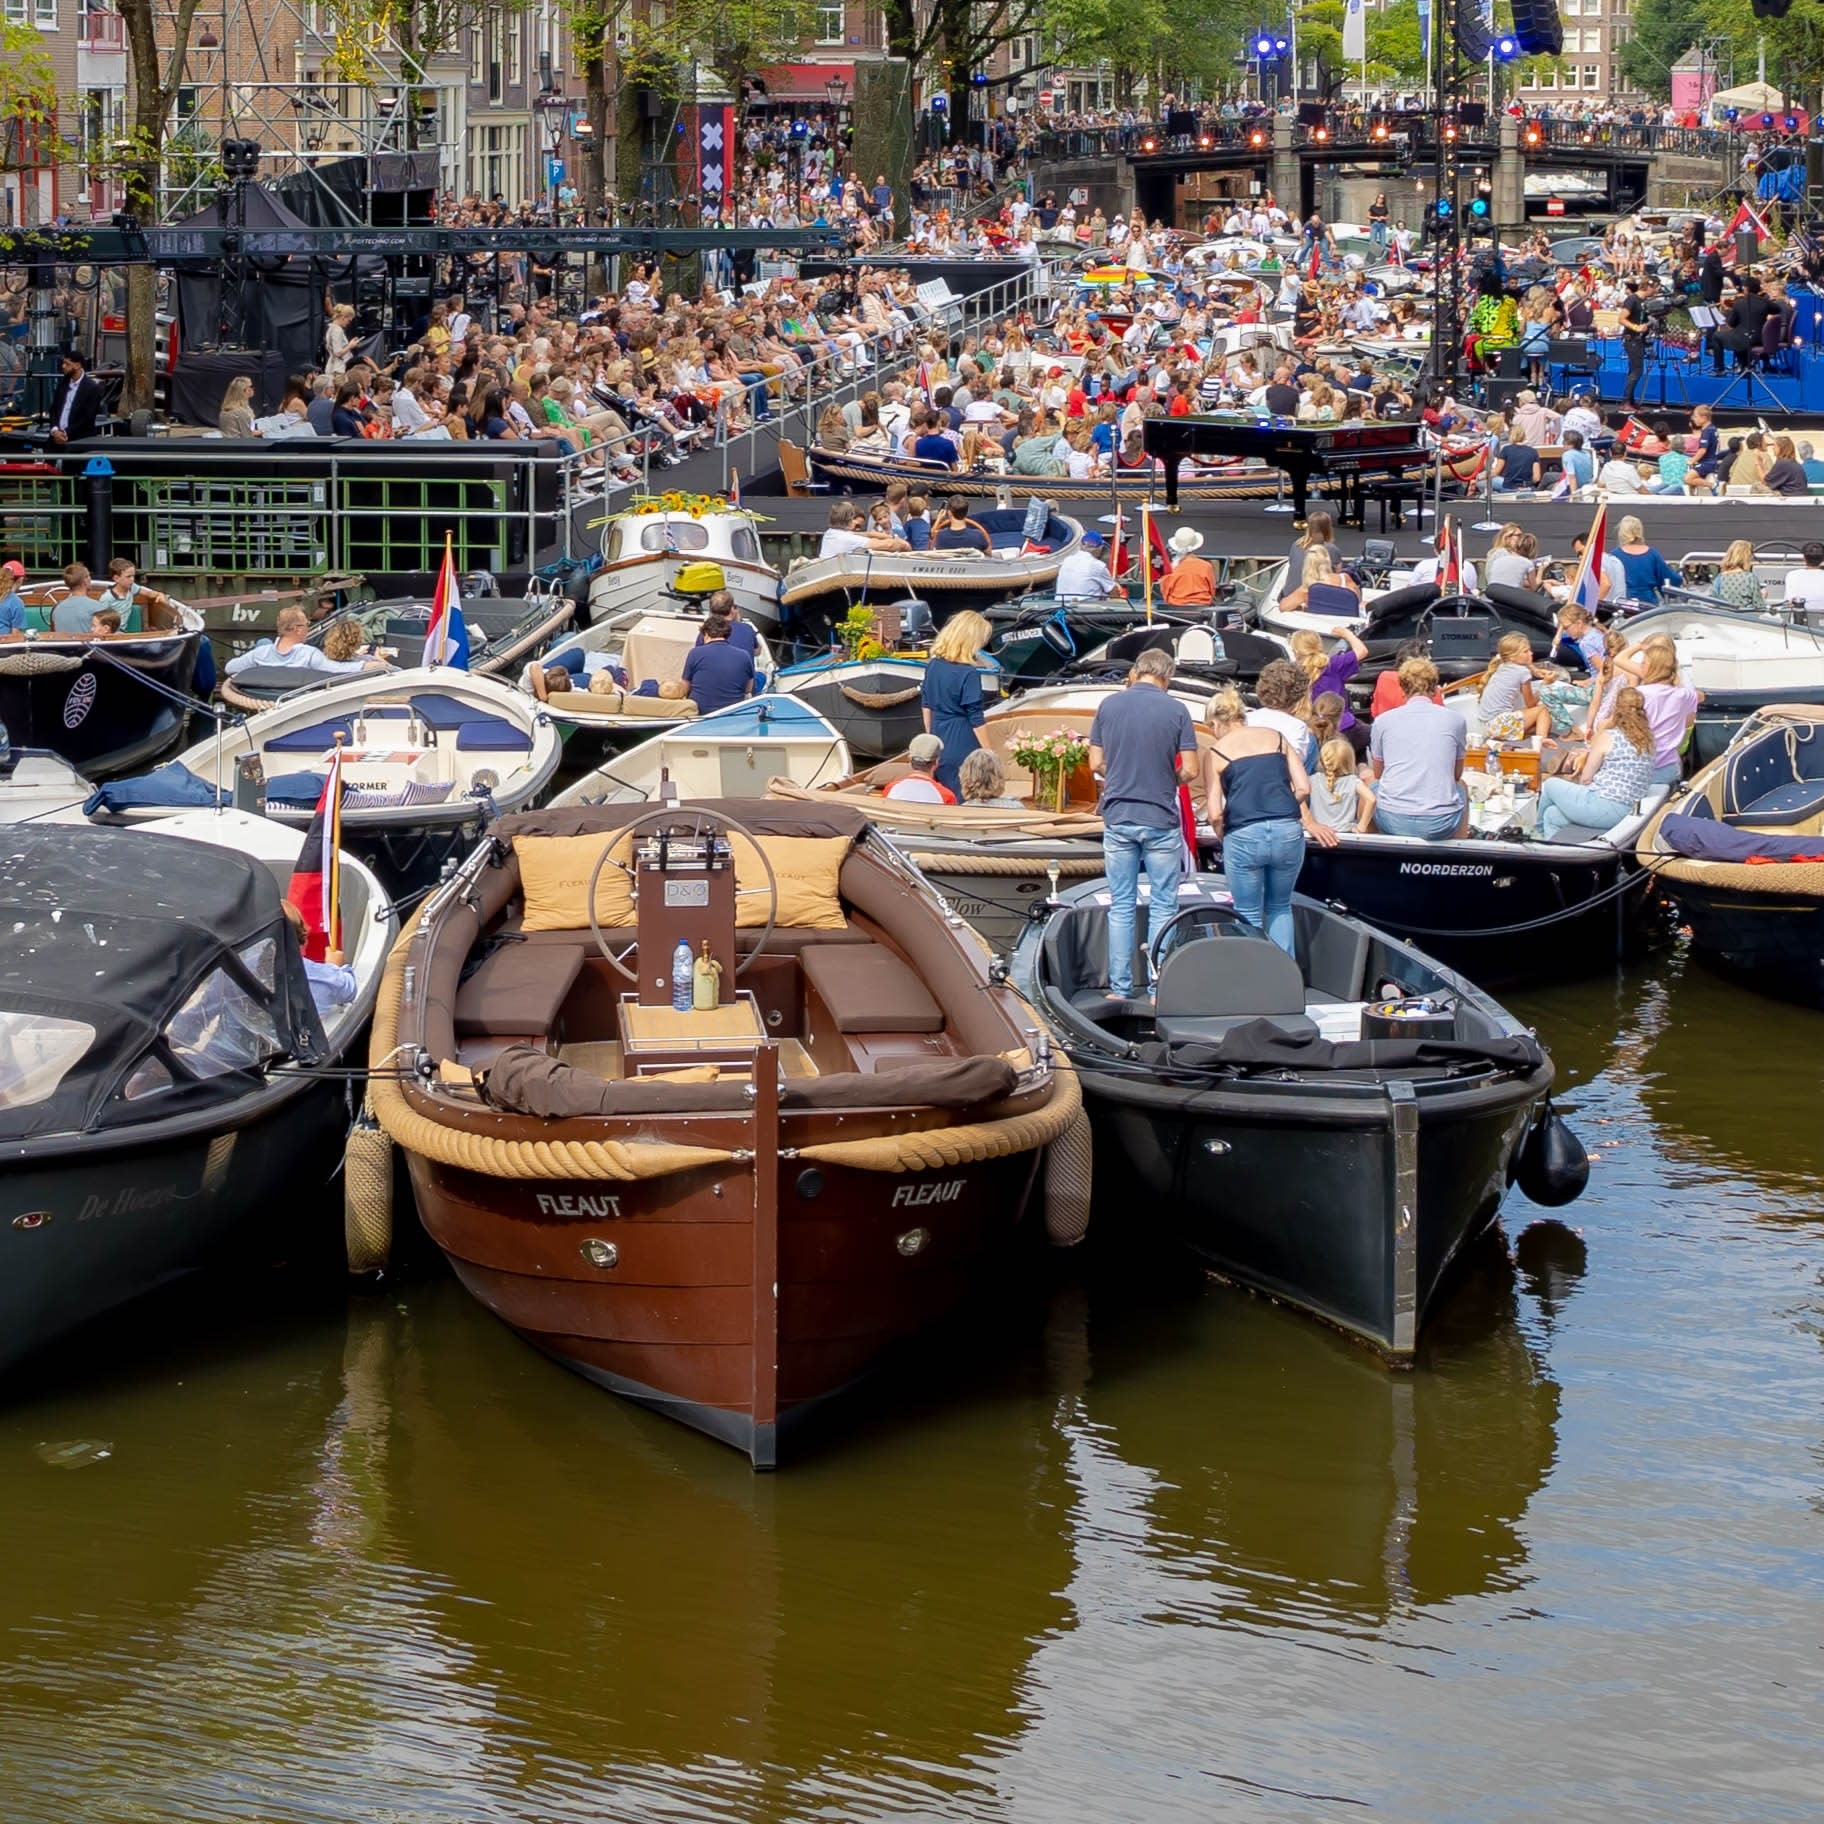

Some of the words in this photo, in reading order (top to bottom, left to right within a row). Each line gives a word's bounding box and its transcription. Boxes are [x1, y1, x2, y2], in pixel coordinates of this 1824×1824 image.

[231, 602, 261, 622] bv
[1399, 862, 1494, 876] NOORDERZON
[891, 1179, 967, 1208] FLEAUT
[536, 1193, 621, 1217] FLEAUT
